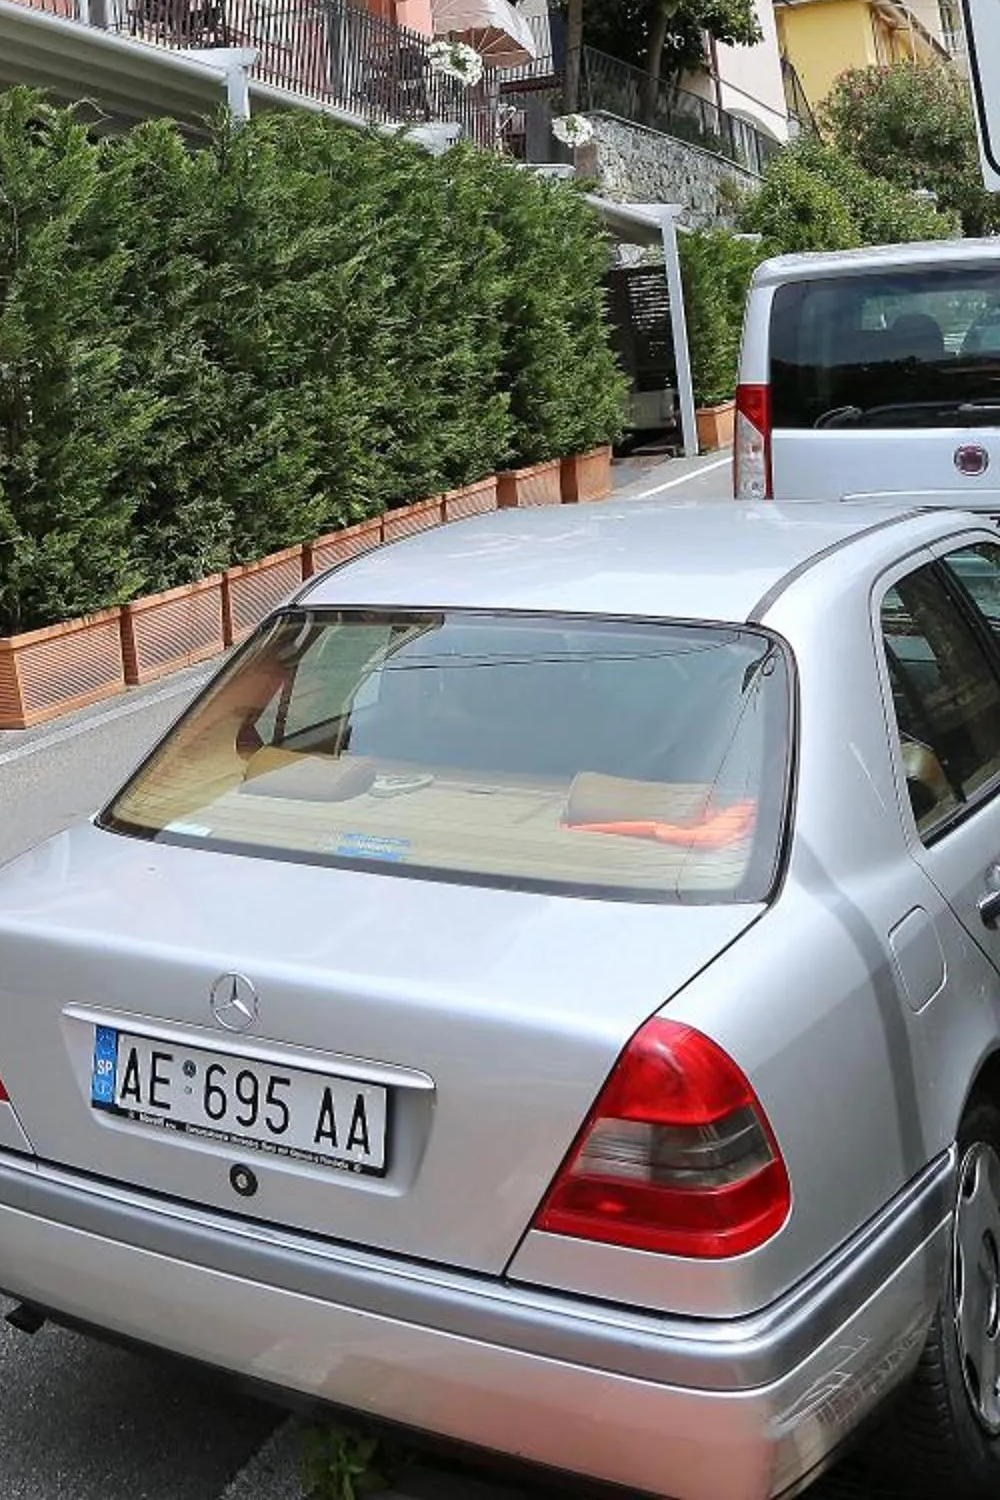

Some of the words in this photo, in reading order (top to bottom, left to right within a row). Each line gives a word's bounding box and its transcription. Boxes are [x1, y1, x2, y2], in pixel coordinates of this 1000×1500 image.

[97, 1059, 113, 1076] SP
[120, 1047, 174, 1110] AE
[204, 1063, 291, 1135] 695
[314, 1086, 370, 1155] AA
